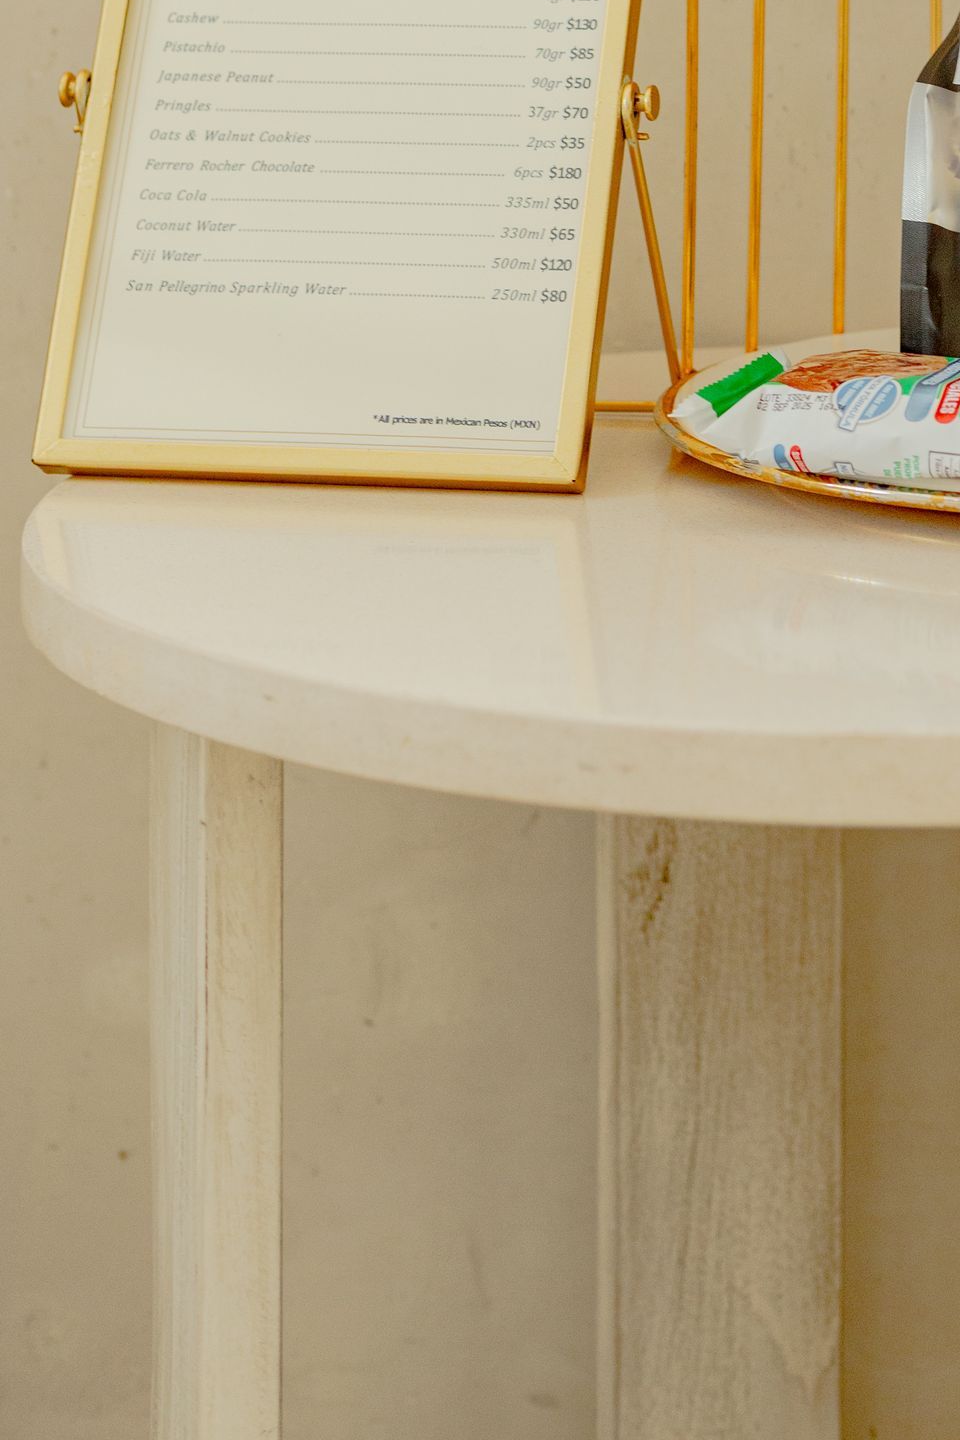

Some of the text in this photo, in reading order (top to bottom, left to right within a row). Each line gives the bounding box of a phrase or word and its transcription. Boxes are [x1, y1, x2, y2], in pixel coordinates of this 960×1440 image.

[167, 12, 598, 32] Cashew 90gr $130
[163, 41, 595, 62] Pistachio 70gr $85
[157, 70, 592, 91] Japanese Peanut 90gr $50
[155, 99, 589, 121] Pringles 37gr $70
[149, 129, 585, 151] Oats & Walnut Cookies 2pcs $35
[144, 159, 582, 181] Ferrero Rocher Chocolate 6pcs $180
[139, 188, 579, 211] Coca Cola 335ml $50
[135, 219, 576, 242] Coconut Water 330ml $65
[131, 249, 573, 272] Fiji Water 500ml $120
[125, 280, 568, 304] San Pellegrino Sparkling Water 250ml $80
[392, 415, 417, 425] prices
[419, 417, 433, 425] are
[435, 416, 443, 425] in
[446, 417, 482, 427] Mexican
[484, 418, 508, 428] Pesos
